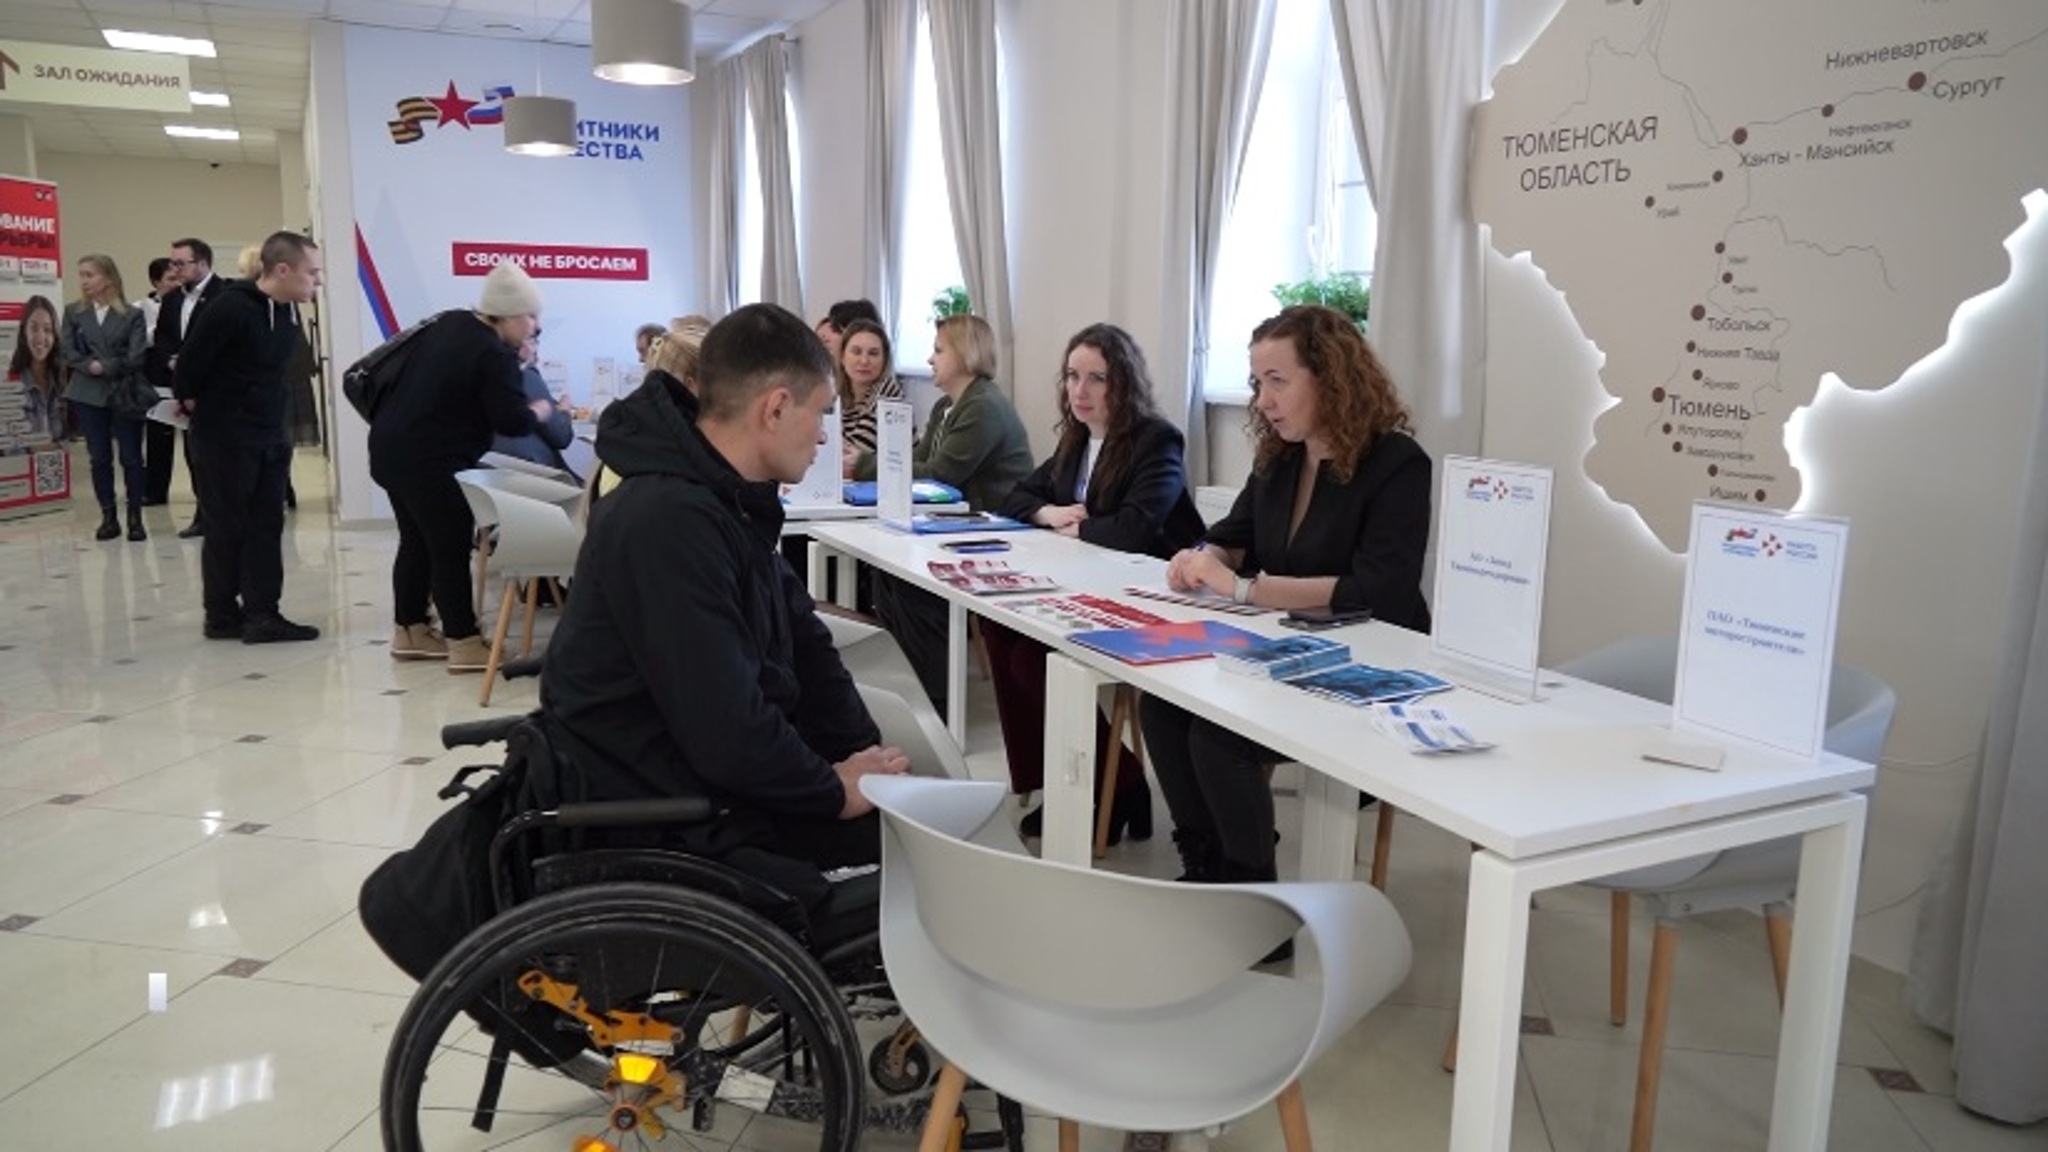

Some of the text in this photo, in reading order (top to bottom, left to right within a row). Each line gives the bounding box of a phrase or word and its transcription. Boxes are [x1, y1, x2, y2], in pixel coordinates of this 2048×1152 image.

[1825, 30, 1990, 71] Нижневартовск
[33, 64, 180, 88] ЗАЛ ОЖИДАНИЯ
[1932, 75, 2005, 102] Сургут
[576, 120, 660, 142] ИТНИКИ
[1502, 115, 1659, 159] ТЮМЕНСКАЯ
[574, 140, 645, 162] ЕСТВА
[1737, 148, 1791, 168] Ханты
[1806, 138, 1896, 161] Мансийск
[1520, 158, 1632, 192] ОБЛАСТЬ
[0, 212, 56, 235] ВАНИЕ
[529, 254, 553, 269] НЕ
[554, 255, 638, 272] БРОСАЕМ
[1707, 316, 1771, 332] Тобольск
[1668, 394, 1751, 421] Тюмень
